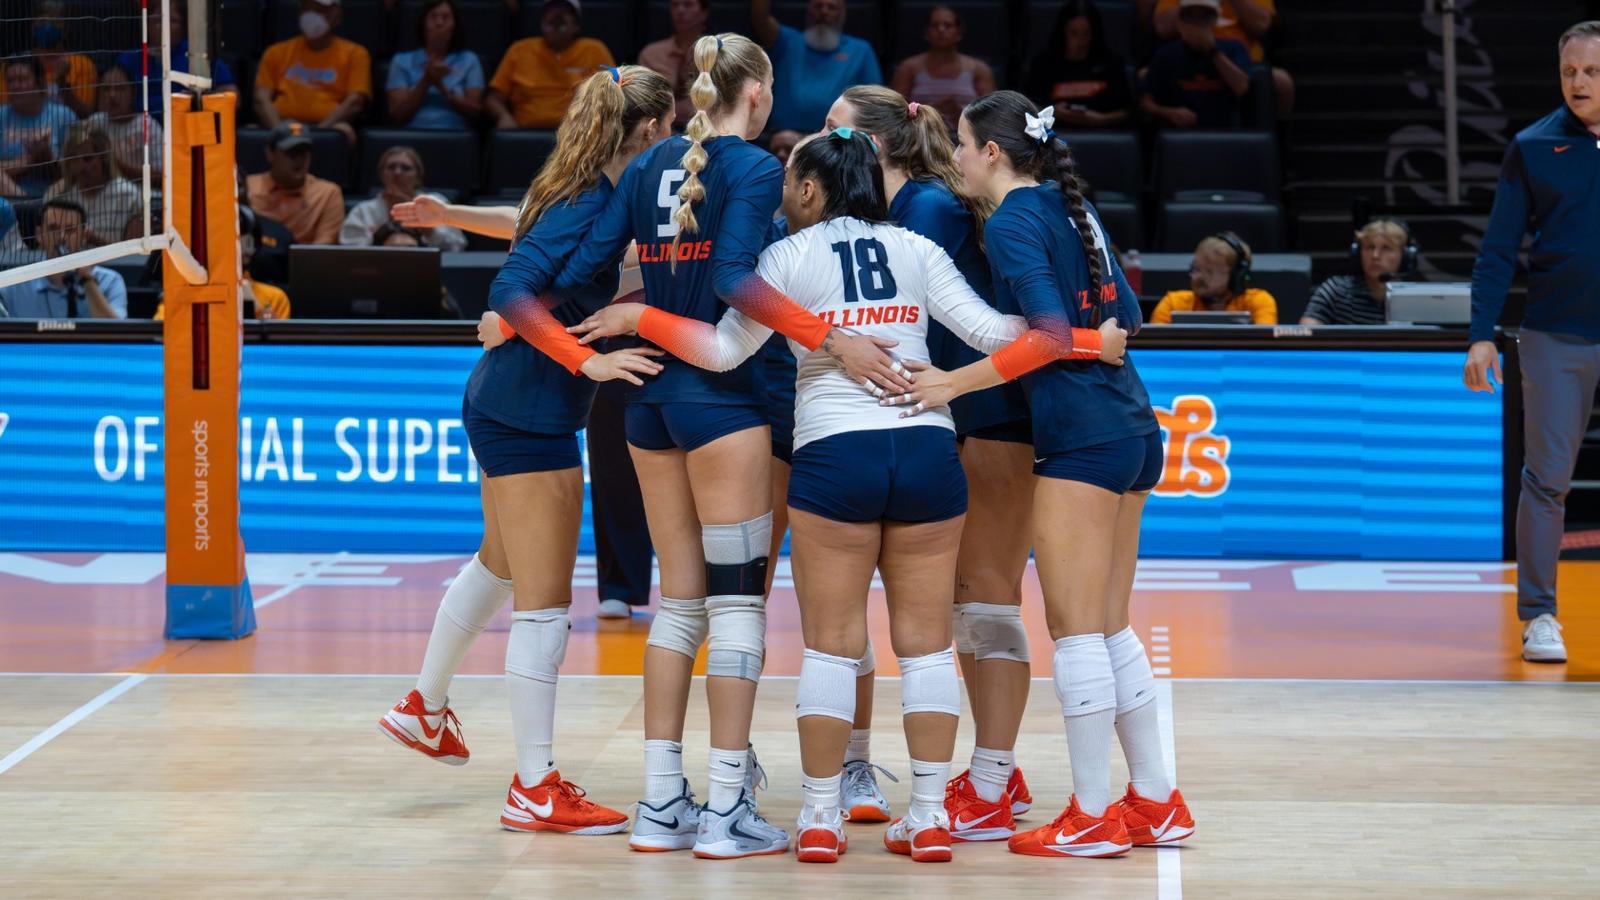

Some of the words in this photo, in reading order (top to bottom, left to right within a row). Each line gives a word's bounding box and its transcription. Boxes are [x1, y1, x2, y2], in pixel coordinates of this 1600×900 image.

[657, 169, 687, 238] 5
[831, 236, 898, 303] 18
[94, 415, 318, 482] OFIAL
[192, 420, 210, 478] sports
[192, 480, 211, 551] imports
